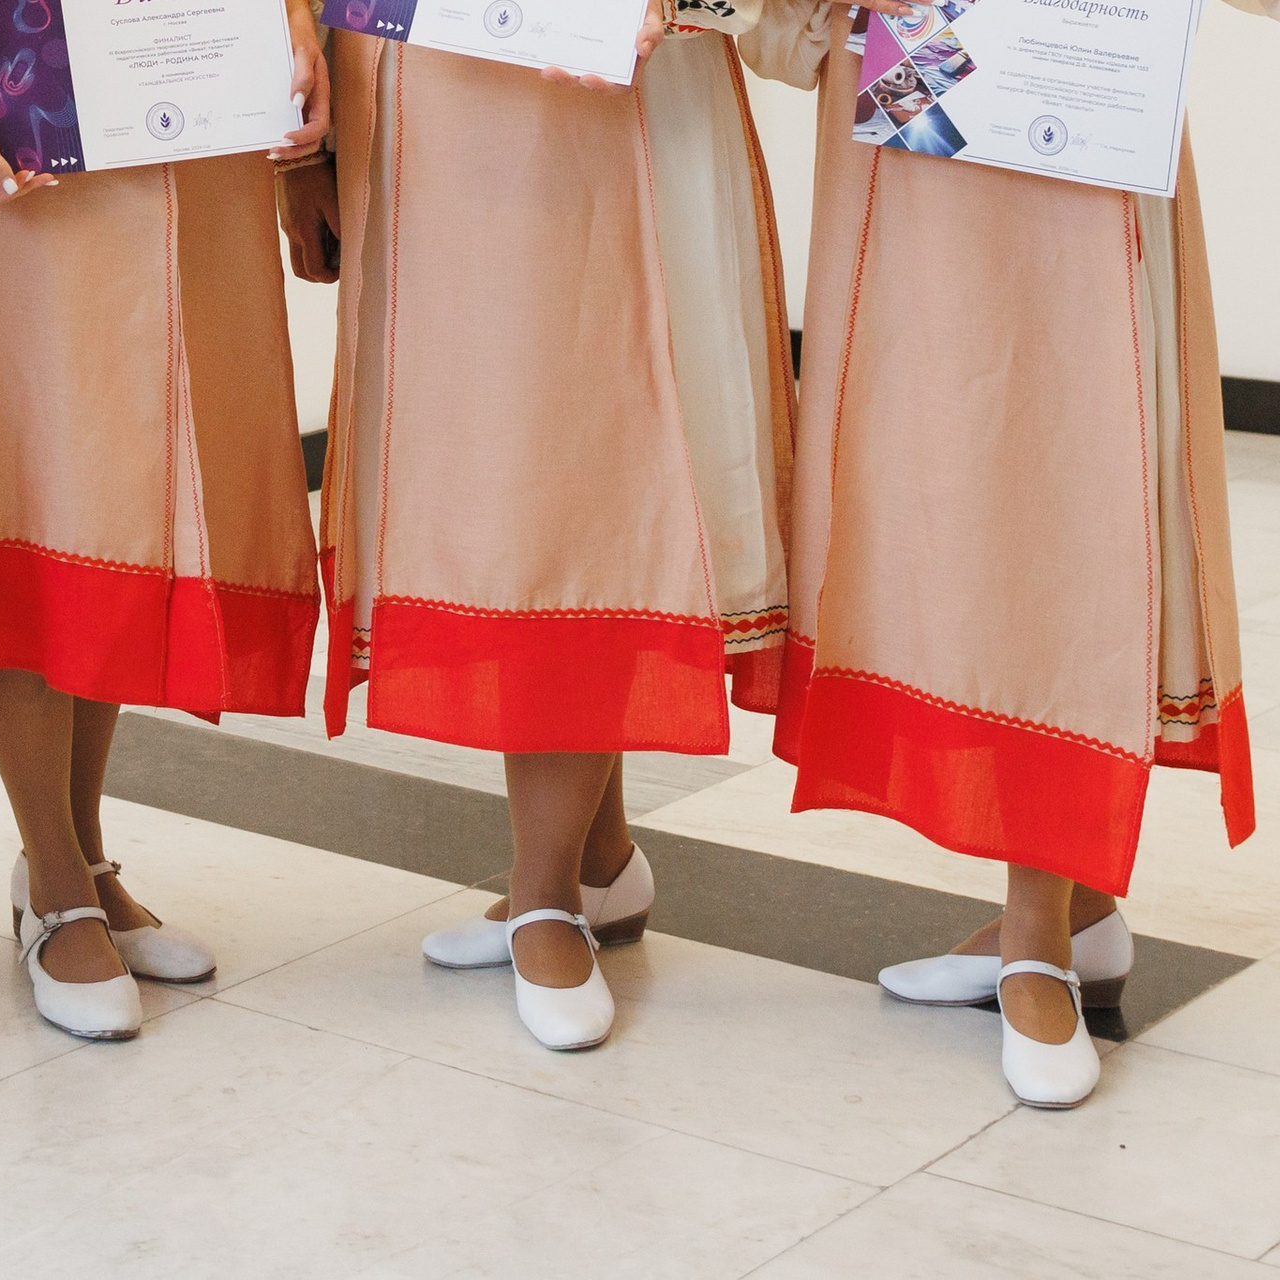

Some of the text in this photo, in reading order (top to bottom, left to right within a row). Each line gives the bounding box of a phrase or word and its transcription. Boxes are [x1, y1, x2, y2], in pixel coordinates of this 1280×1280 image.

[110, 6, 225, 27] Суслова Александра Сергеевна
[153, 34, 192, 45] ФИНАЛИСТ
[128, 59, 158, 70] «ЛЮДИ
[165, 54, 199, 65] РОДИНА
[201, 51, 224, 60] МОЯ»
[1069, 44, 1092, 54] Юлии
[1093, 48, 1140, 63] Валерьевне
